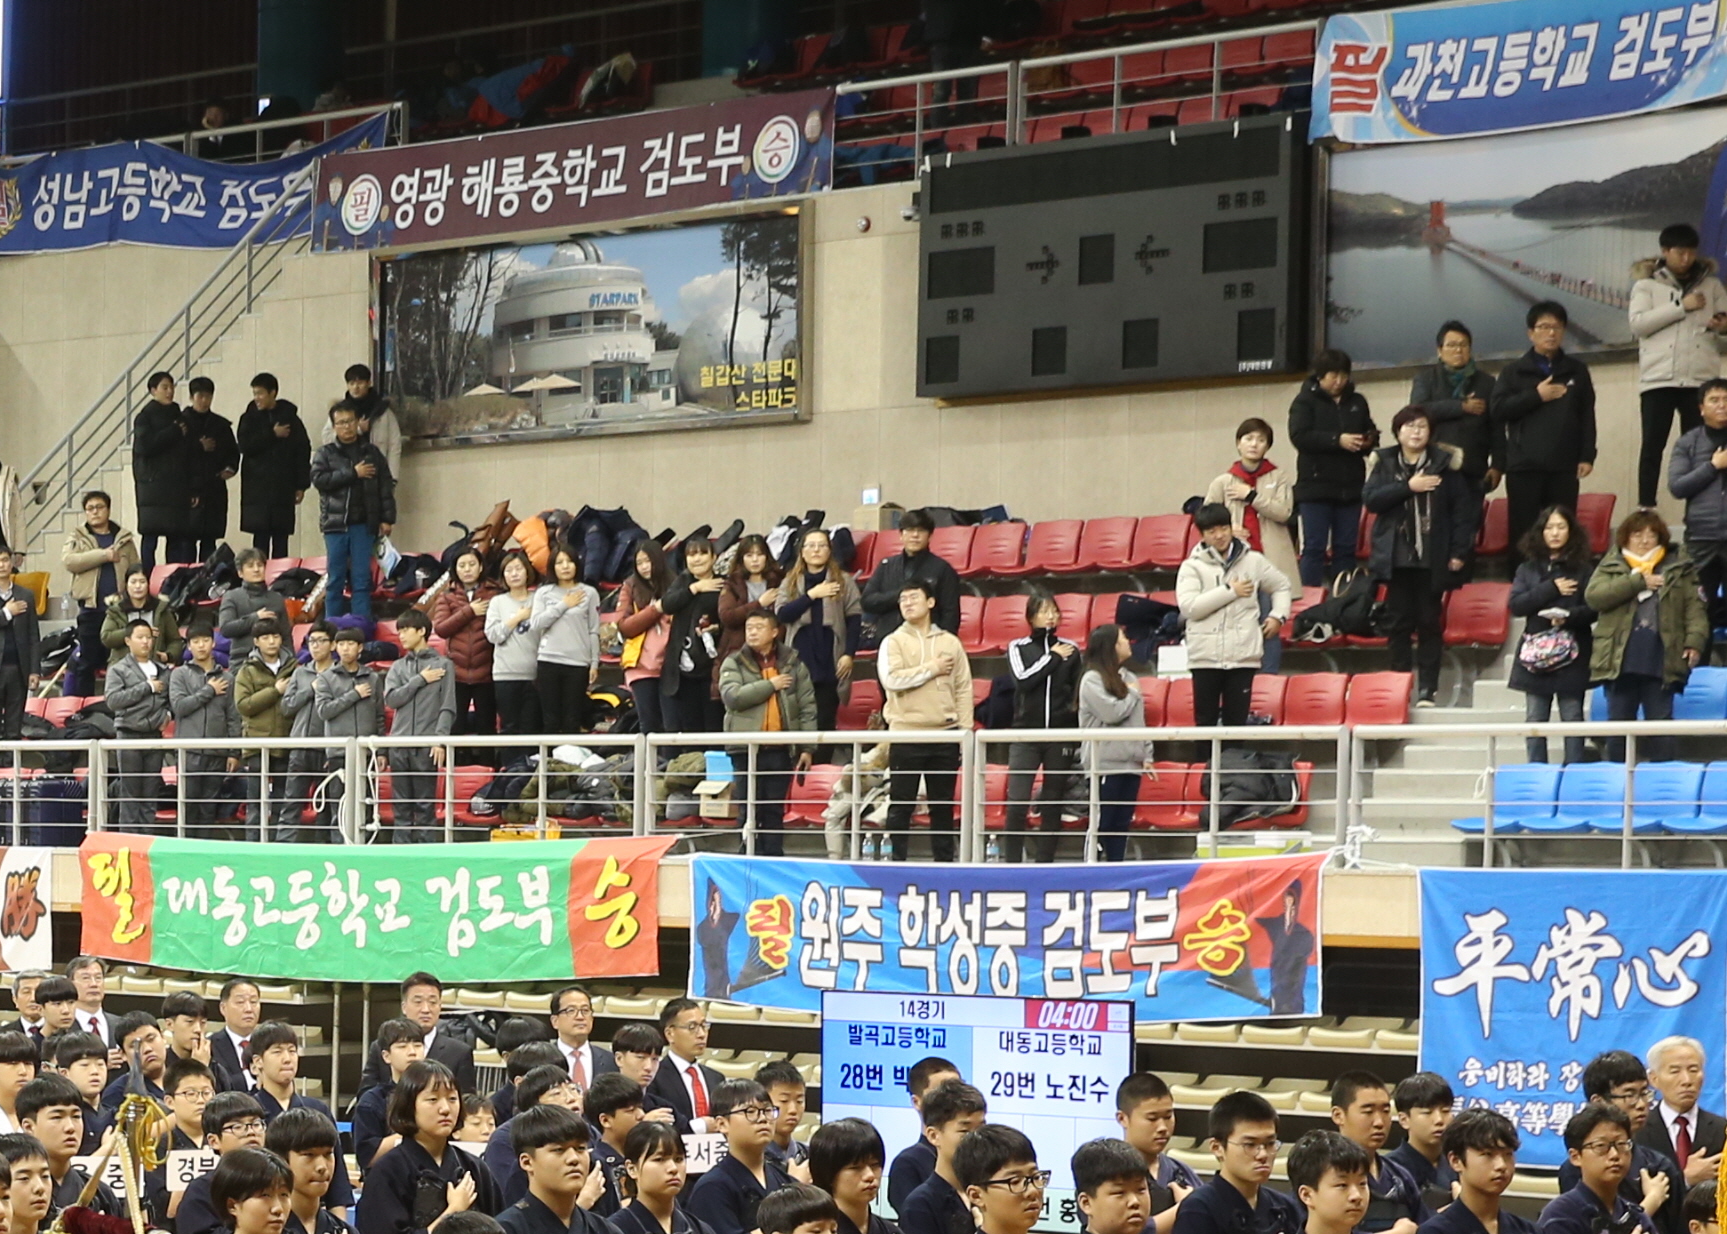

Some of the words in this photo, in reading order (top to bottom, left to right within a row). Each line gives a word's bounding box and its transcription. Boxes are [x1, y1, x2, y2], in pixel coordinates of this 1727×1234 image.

[1330, 43, 1388, 114] 필
[1390, 21, 1599, 103] 과천고등학교
[1609, 1, 1719, 81] 검도부
[390, 163, 455, 230] 영광
[460, 143, 628, 218] 해룡중학교
[639, 123, 745, 198] 검도부
[763, 130, 792, 167] 승
[33, 162, 207, 231] 성남고등학교
[351, 187, 372, 222] 필
[700, 363, 747, 388] 칠갑산
[88, 847, 144, 944] 필
[161, 861, 411, 949] 대동고등학교
[426, 865, 555, 957] 검도부
[585, 855, 640, 949] 승
[746, 896, 794, 969] 필
[799, 881, 885, 990] 원주
[899, 885, 1027, 998] 학성중
[1041, 885, 1177, 998] 검도부
[1183, 898, 1250, 976] 승
[1433, 907, 1711, 1043] 平常心
[848, 1024, 947, 1049] 발곡고등학교
[999, 1031, 1102, 1056] 대동고등학교
[899, 1000, 946, 1020] 14경기
[1038, 1002, 1100, 1029] 04:00
[840, 1063, 884, 1091] 28번
[991, 1072, 1035, 1099] 29번
[1046, 1074, 1110, 1103] 노진수
[1459, 1057, 1550, 1092] 웅비하라
